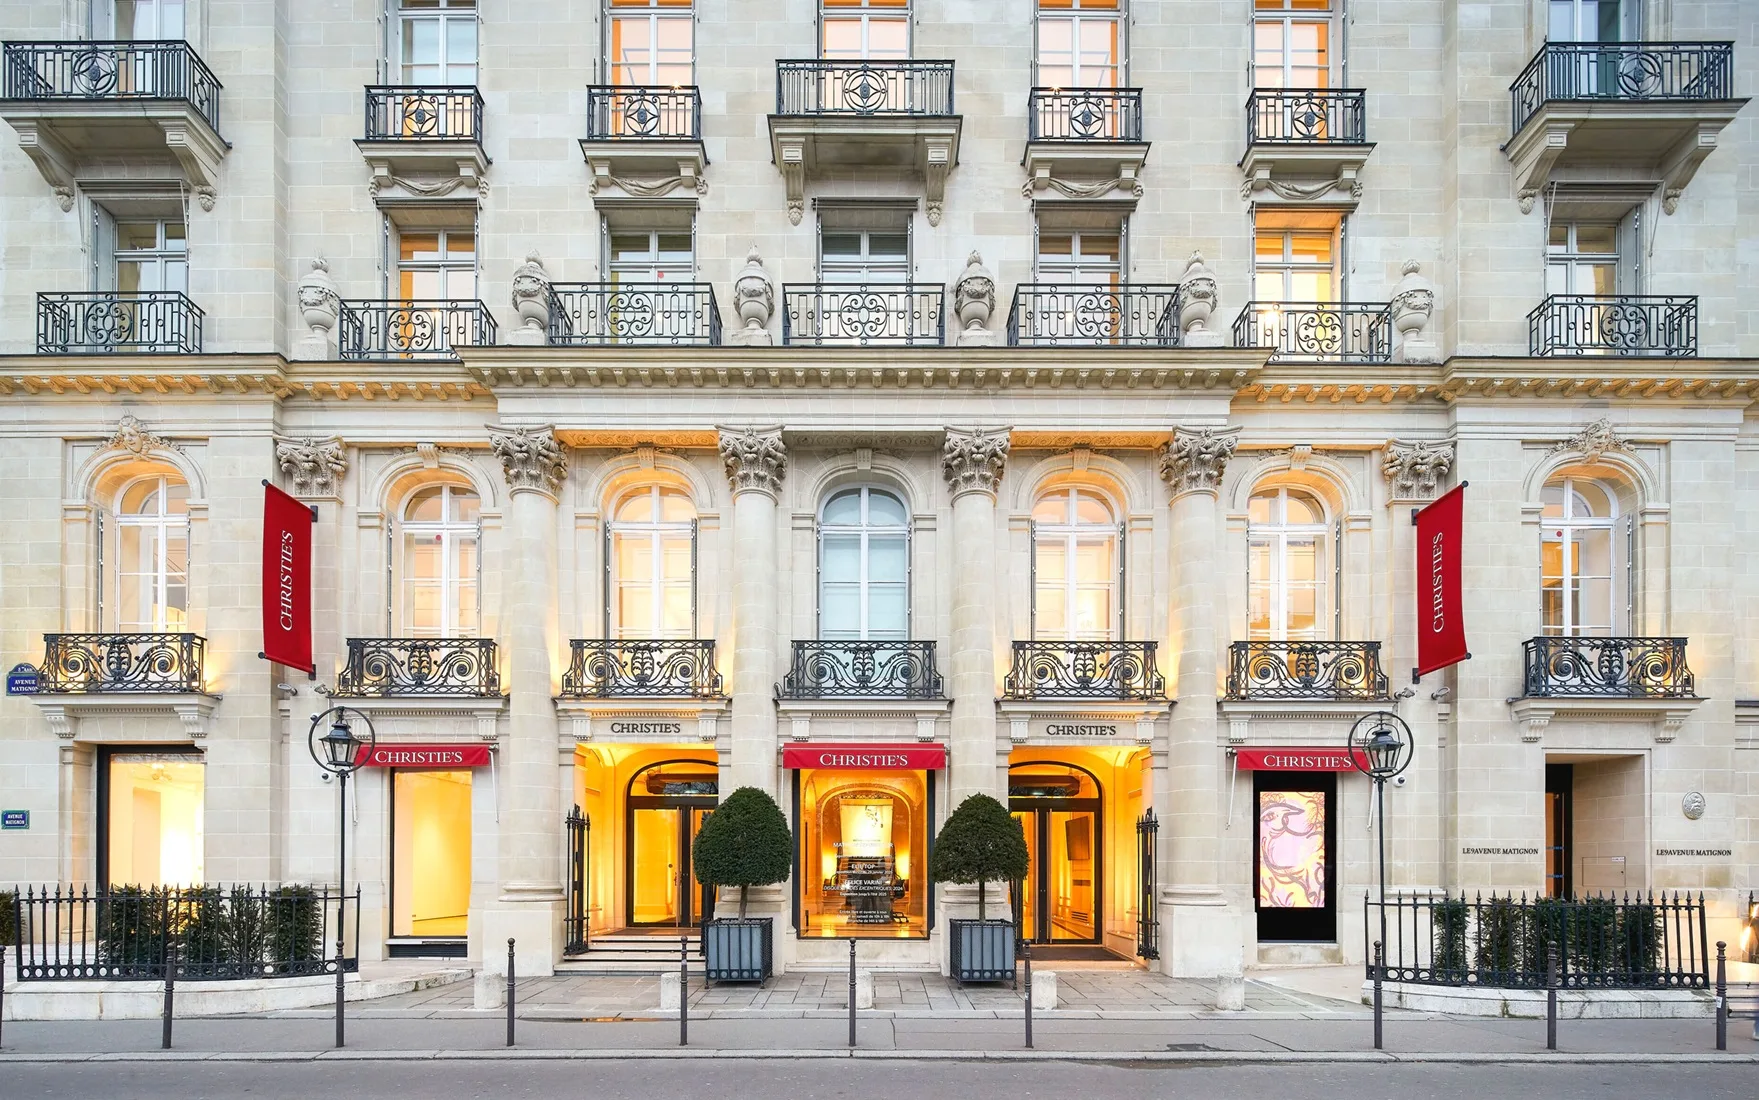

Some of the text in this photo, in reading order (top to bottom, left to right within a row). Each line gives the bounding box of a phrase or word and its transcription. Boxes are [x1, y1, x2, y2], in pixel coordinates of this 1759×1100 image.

[279, 529, 294, 631] CHRISTIE'S
[1432, 532, 1445, 633] CHRISTIE'S
[610, 722, 681, 734] CHRISTIE'S
[1046, 724, 1117, 736] CHRISTIE'S
[374, 750, 463, 763] CHRISTIE'S
[819, 753, 909, 766] CHRISTIE'S
[1263, 754, 1353, 768] CHRISTIE'S
